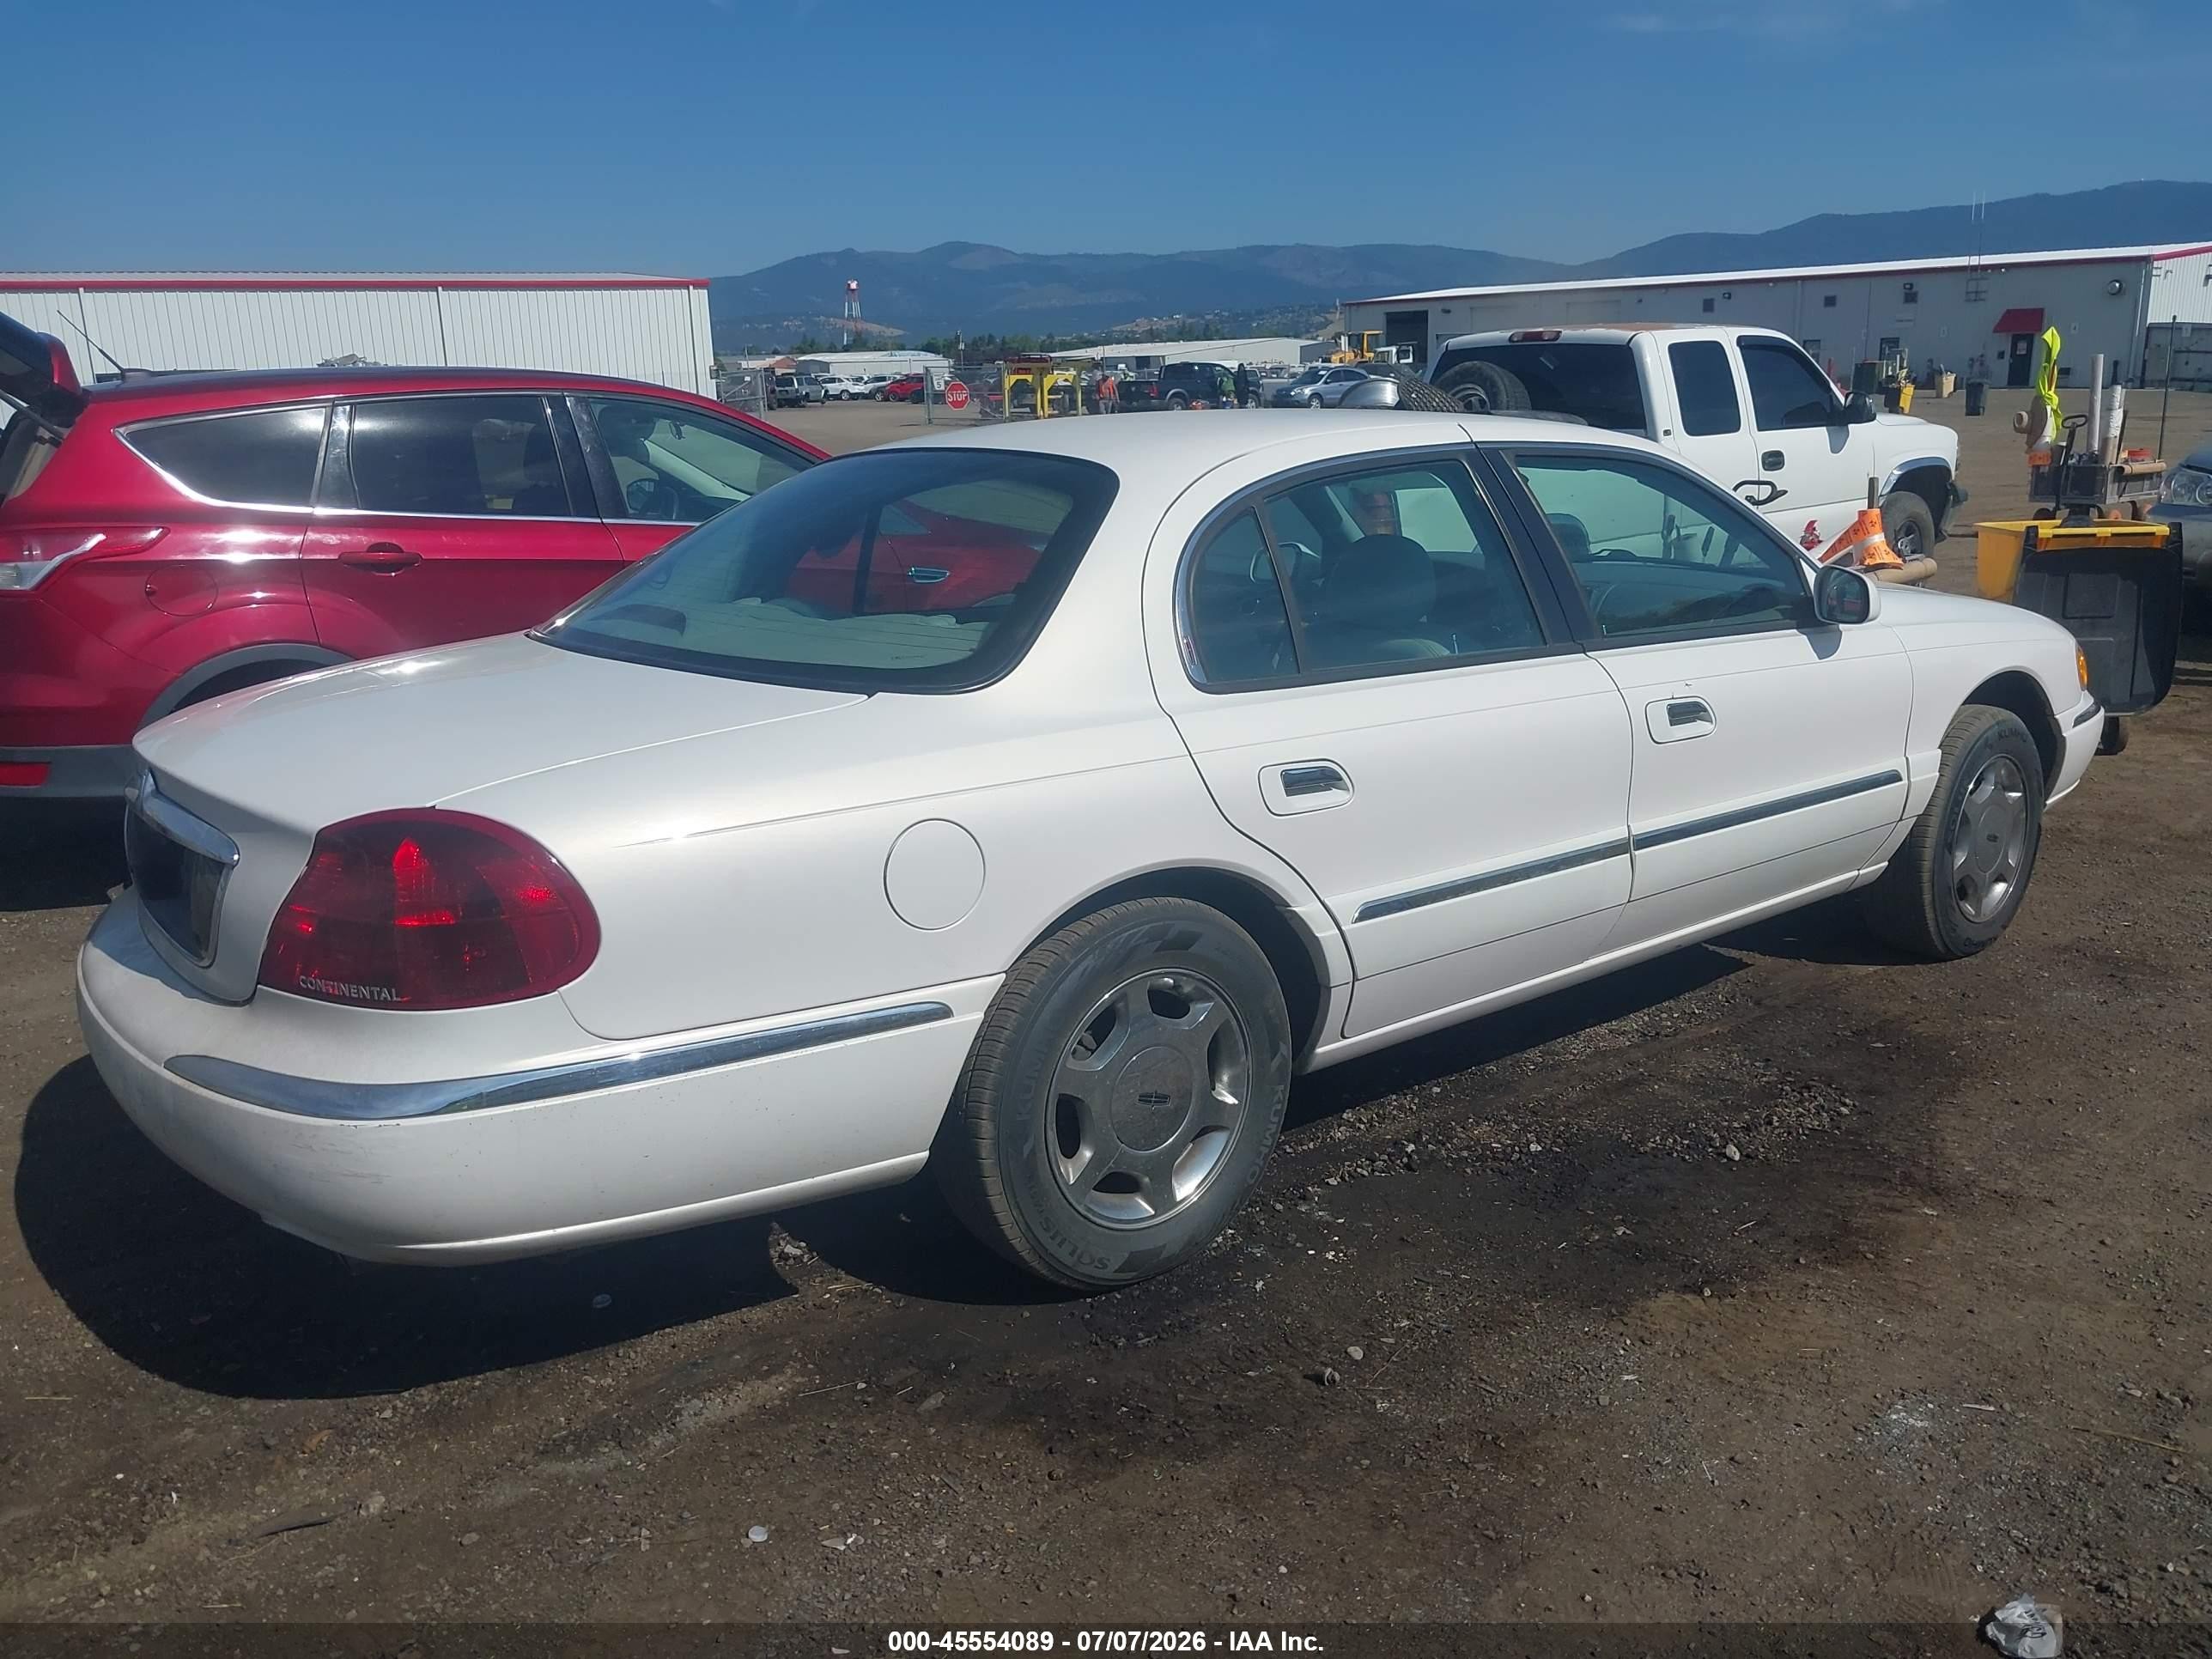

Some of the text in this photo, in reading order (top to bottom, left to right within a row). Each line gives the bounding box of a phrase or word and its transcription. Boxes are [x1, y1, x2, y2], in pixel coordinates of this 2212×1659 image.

[947, 391, 968, 402] STOP
[300, 975, 403, 1001] CONTINENTAL
[1247, 1085, 1285, 1185] KUMHO
